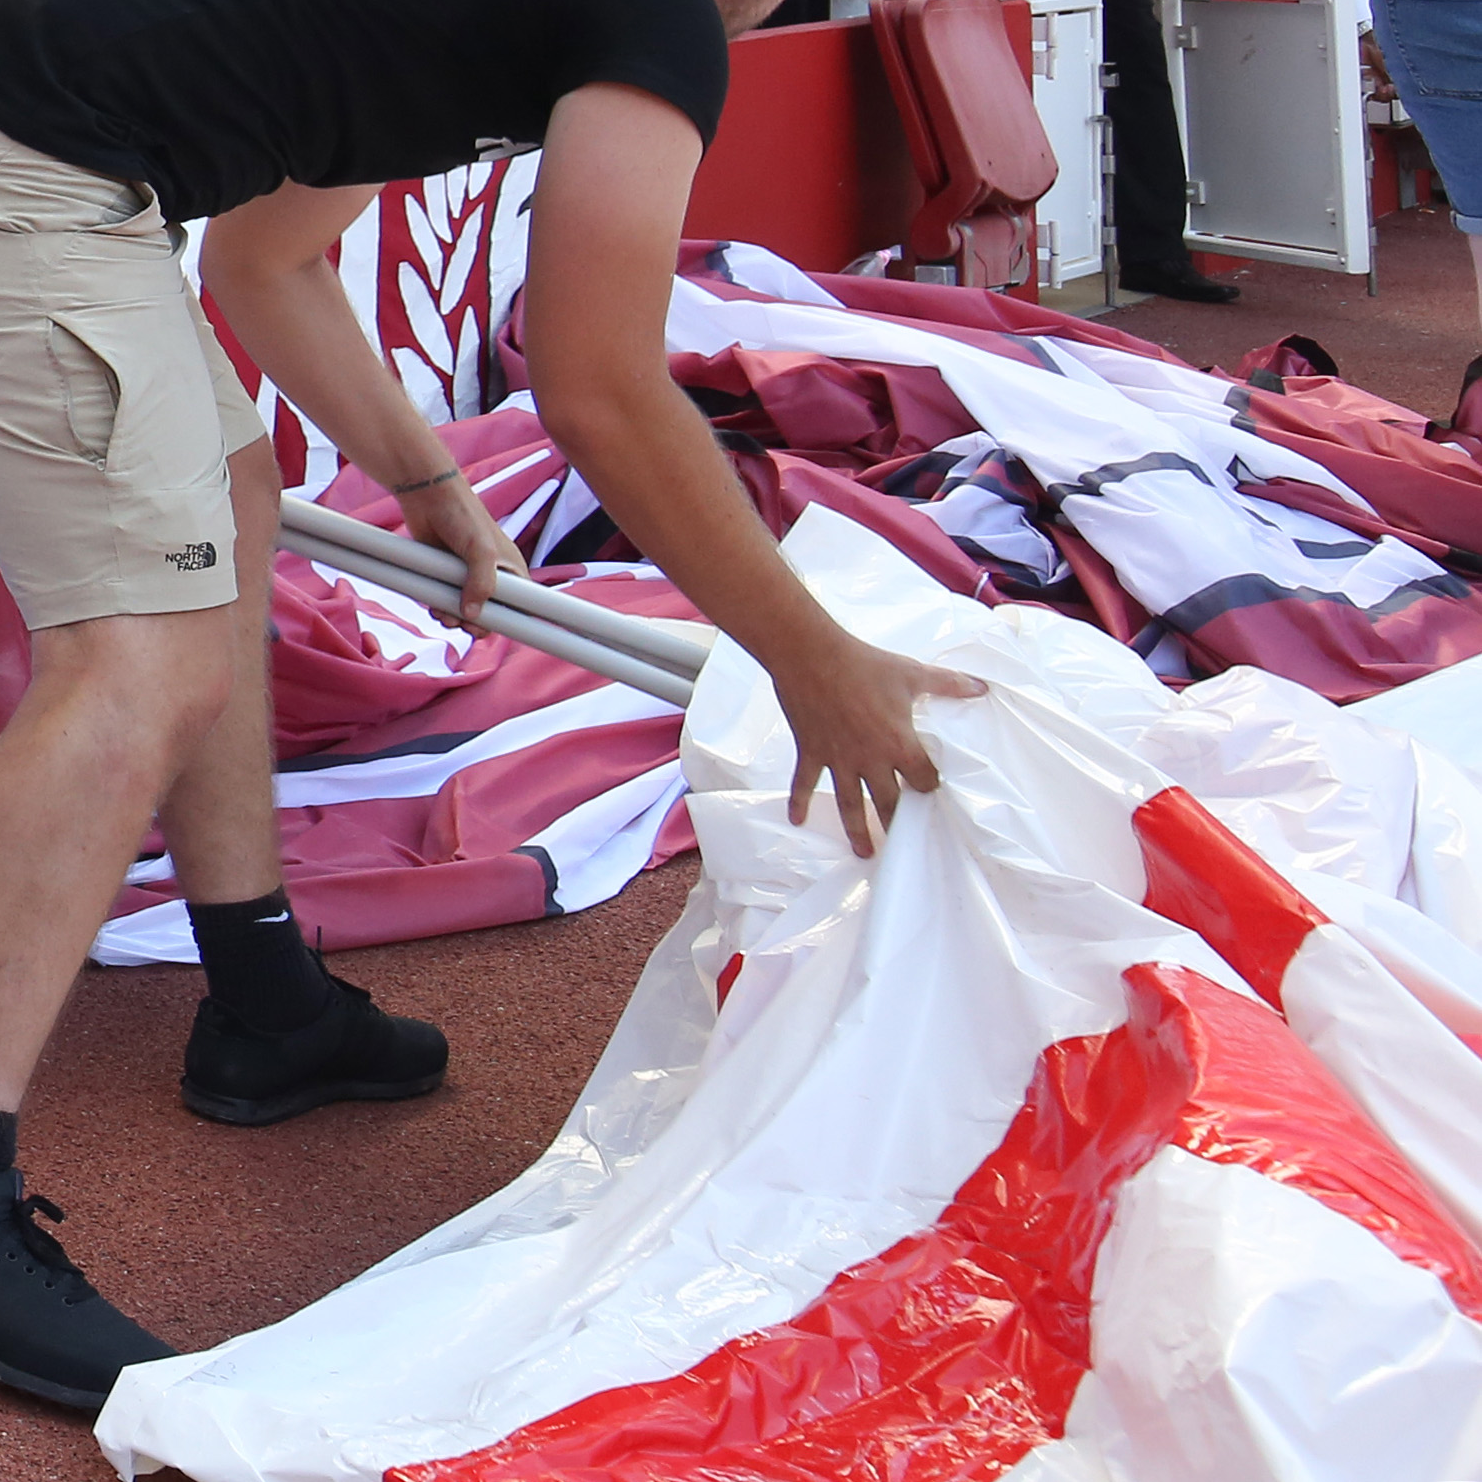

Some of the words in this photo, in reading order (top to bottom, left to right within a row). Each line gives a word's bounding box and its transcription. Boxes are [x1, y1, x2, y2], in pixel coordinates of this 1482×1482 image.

[185, 543, 207, 553] THE
[165, 552, 205, 562] NORTH
[177, 561, 204, 571] FACE
